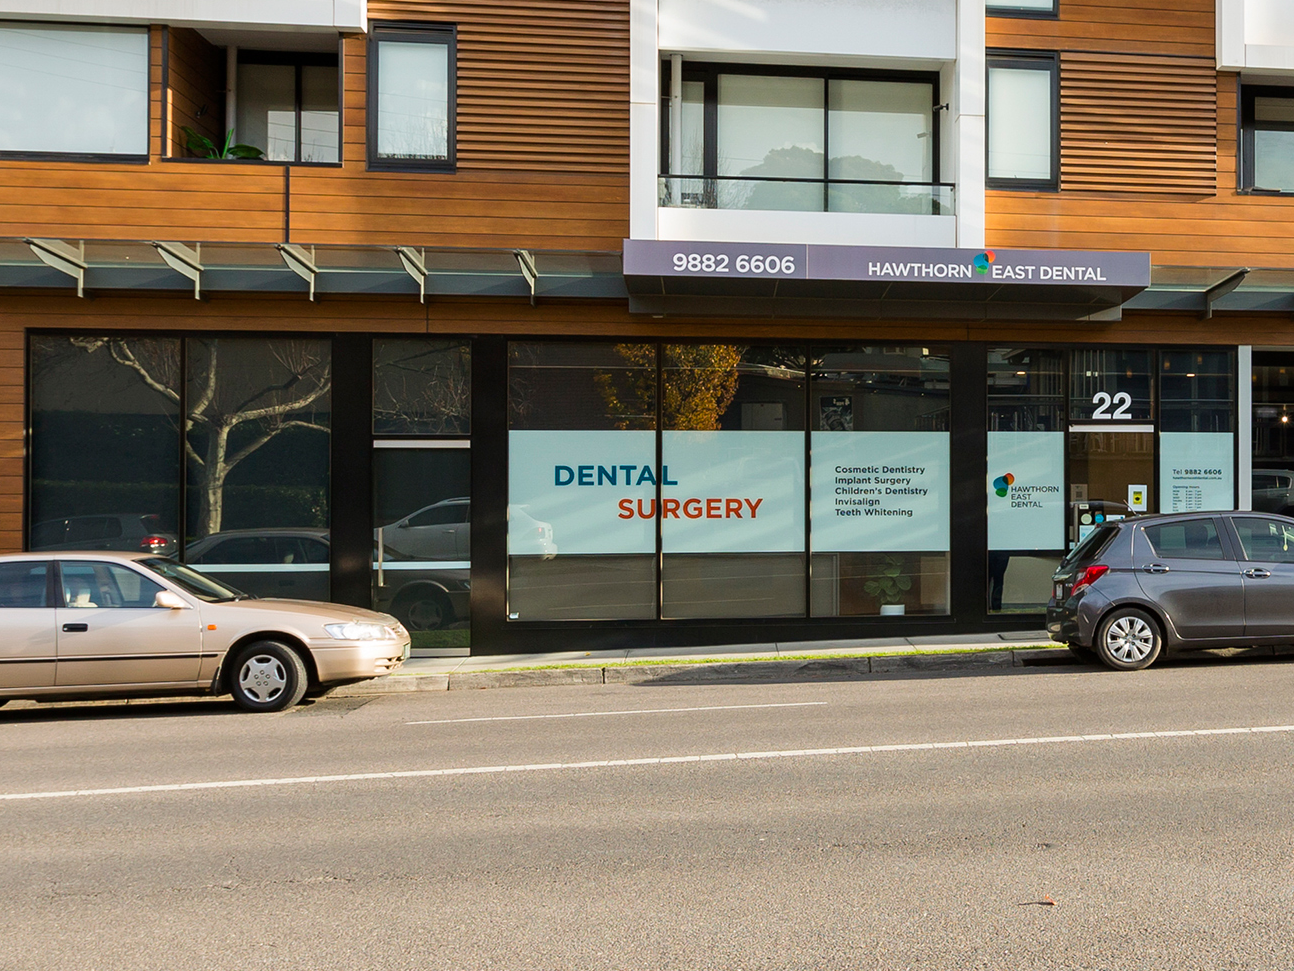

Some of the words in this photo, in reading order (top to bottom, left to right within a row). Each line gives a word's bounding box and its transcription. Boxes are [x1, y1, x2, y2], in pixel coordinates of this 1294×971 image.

[672, 253, 730, 273] 9882
[735, 255, 796, 275] 6606
[868, 262, 972, 278] HAWTHORN
[992, 264, 1036, 280] EAST
[1040, 265, 1107, 281] DENTAL
[1092, 391, 1132, 420] 22
[554, 465, 678, 486] DENTAL
[835, 465, 879, 473] Cosmetic
[882, 465, 925, 475] Dentistry
[835, 476, 872, 485] Implant
[874, 476, 911, 485] Surgery
[835, 487, 882, 495] Children's
[885, 487, 928, 496] Dentistry
[618, 498, 763, 519] SURGERY
[835, 498, 880, 507] Invisalign
[835, 508, 861, 517] Teeth
[864, 508, 913, 518] Whitening
